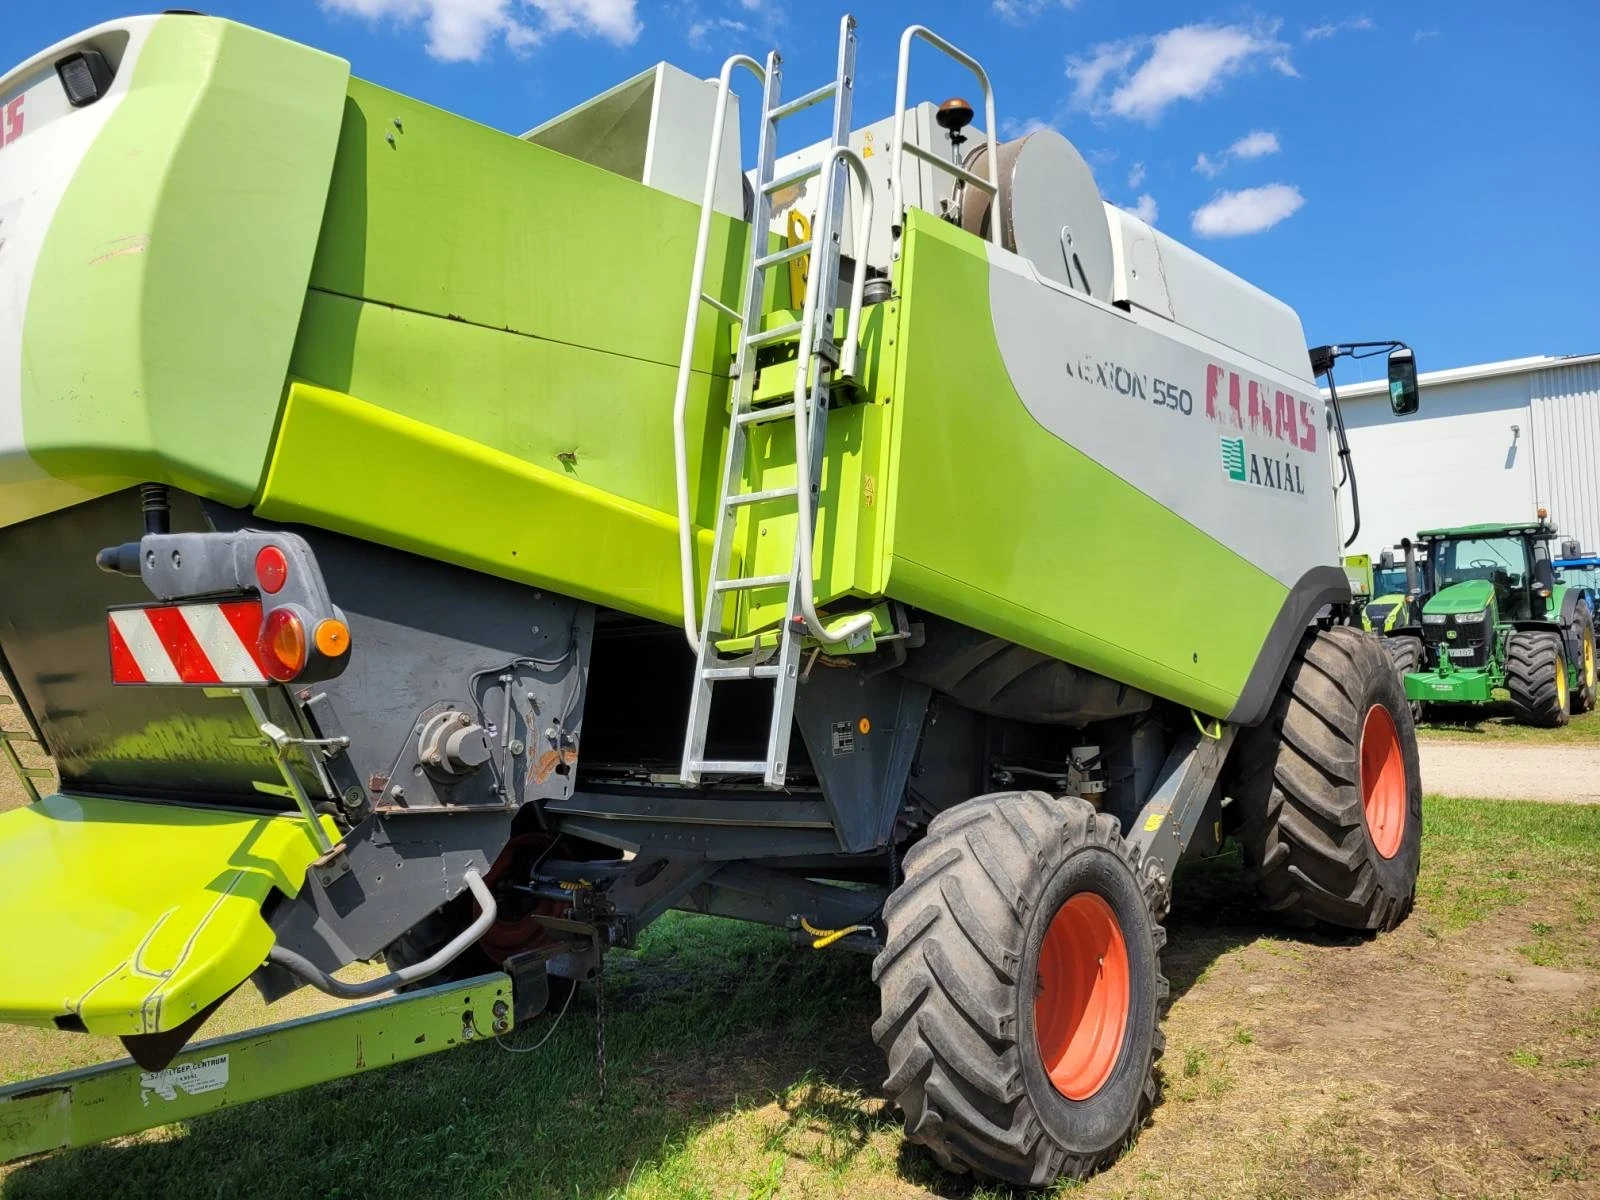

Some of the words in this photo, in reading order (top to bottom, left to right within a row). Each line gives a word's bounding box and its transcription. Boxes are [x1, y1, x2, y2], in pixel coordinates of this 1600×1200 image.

[1153, 378, 1193, 416] 550
[1250, 452, 1305, 495] AXIÁL
[192, 1056, 227, 1070] CENTRUM
